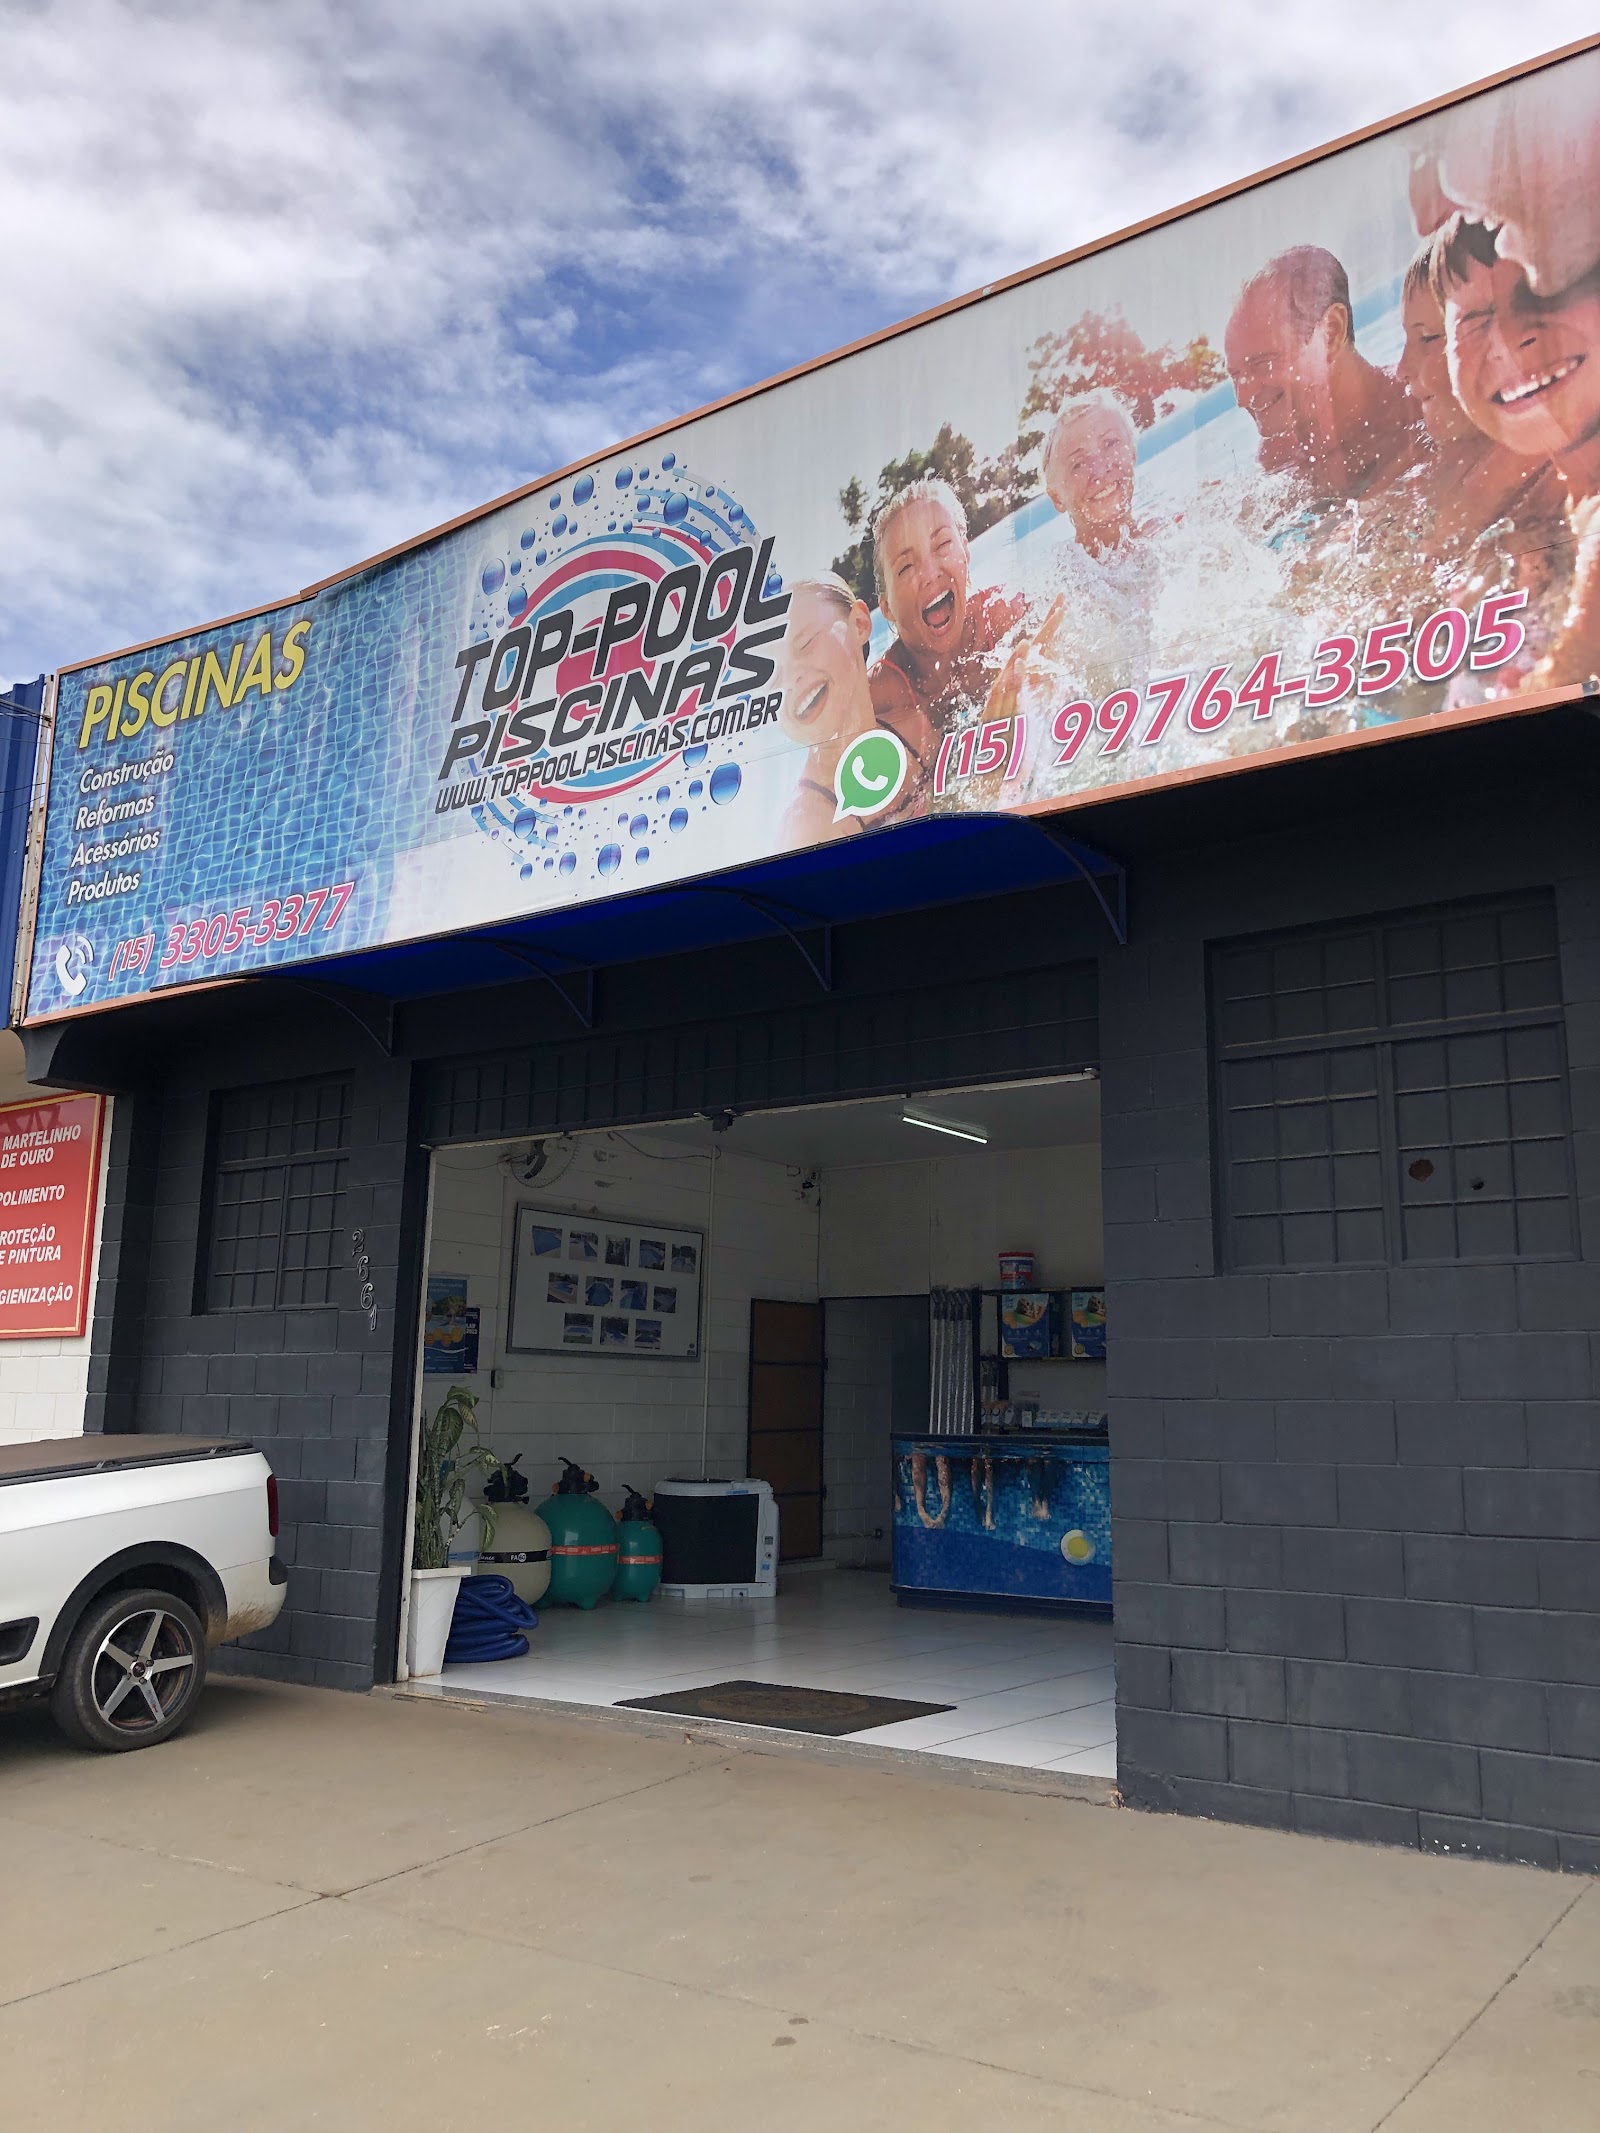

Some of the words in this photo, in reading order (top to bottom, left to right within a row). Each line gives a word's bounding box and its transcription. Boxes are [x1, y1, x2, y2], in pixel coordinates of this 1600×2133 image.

[451, 536, 792, 723] TOP-POOL
[78, 620, 312, 749] PISCINAS
[438, 623, 789, 781] PISCINAS
[933, 714, 1028, 796] (15)
[1050, 588, 1530, 767] 99764-3505
[80, 750, 174, 794] Construção
[435, 691, 783, 815] WWW.TOPPOOLPISCINAS.COM.BR
[75, 794, 155, 831] Reformas
[71, 827, 160, 867] Acessórios
[67, 870, 140, 905] Produtos
[108, 934, 155, 982] (15)
[160, 882, 355, 969] 3305-3377
[0, 1152, 16, 1169] DE
[19, 1146, 54, 1166] OURO
[3, 1124, 82, 1150] MARTELINHO
[8, 1245, 61, 1265] PINTURA
